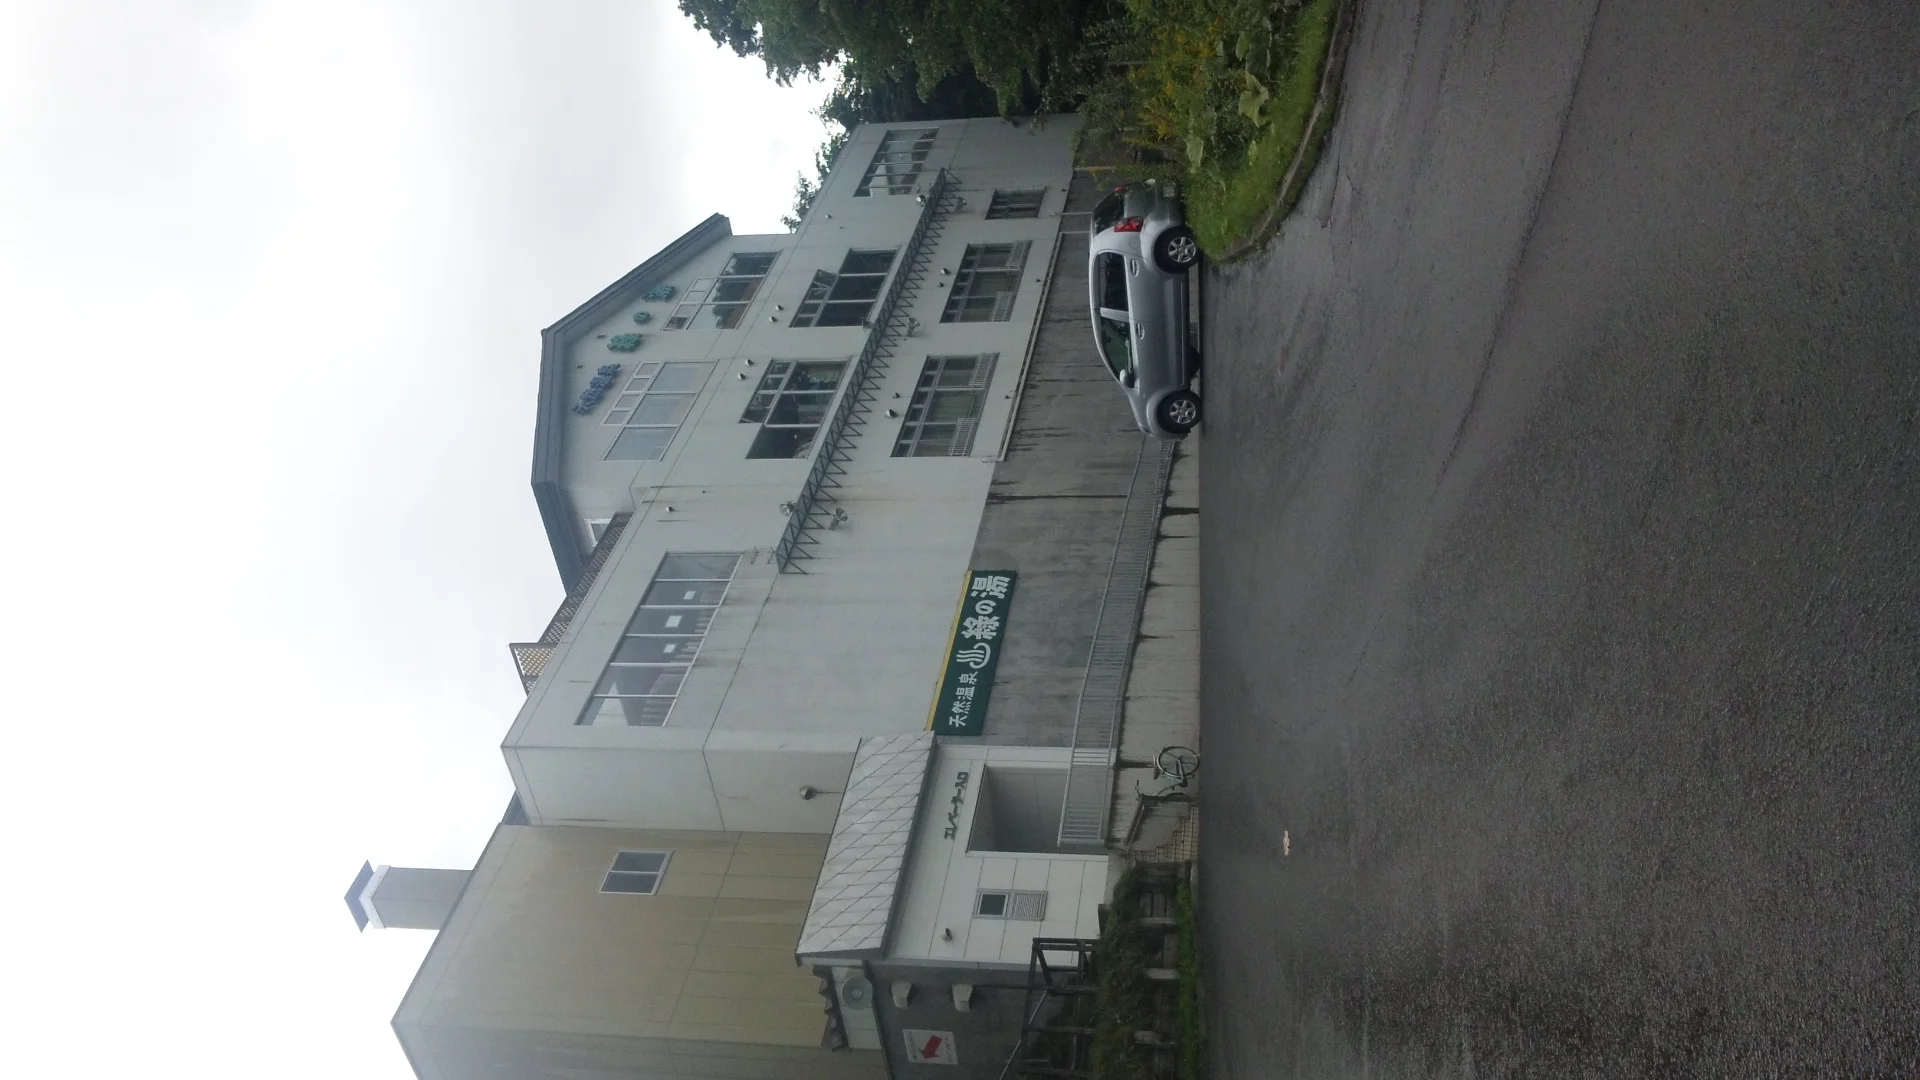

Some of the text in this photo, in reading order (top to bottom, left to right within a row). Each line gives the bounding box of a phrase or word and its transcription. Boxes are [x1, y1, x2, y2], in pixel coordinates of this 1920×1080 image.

[949, 671, 978, 727] 天然温泉
[944, 772, 968, 840] エレベーター入口
